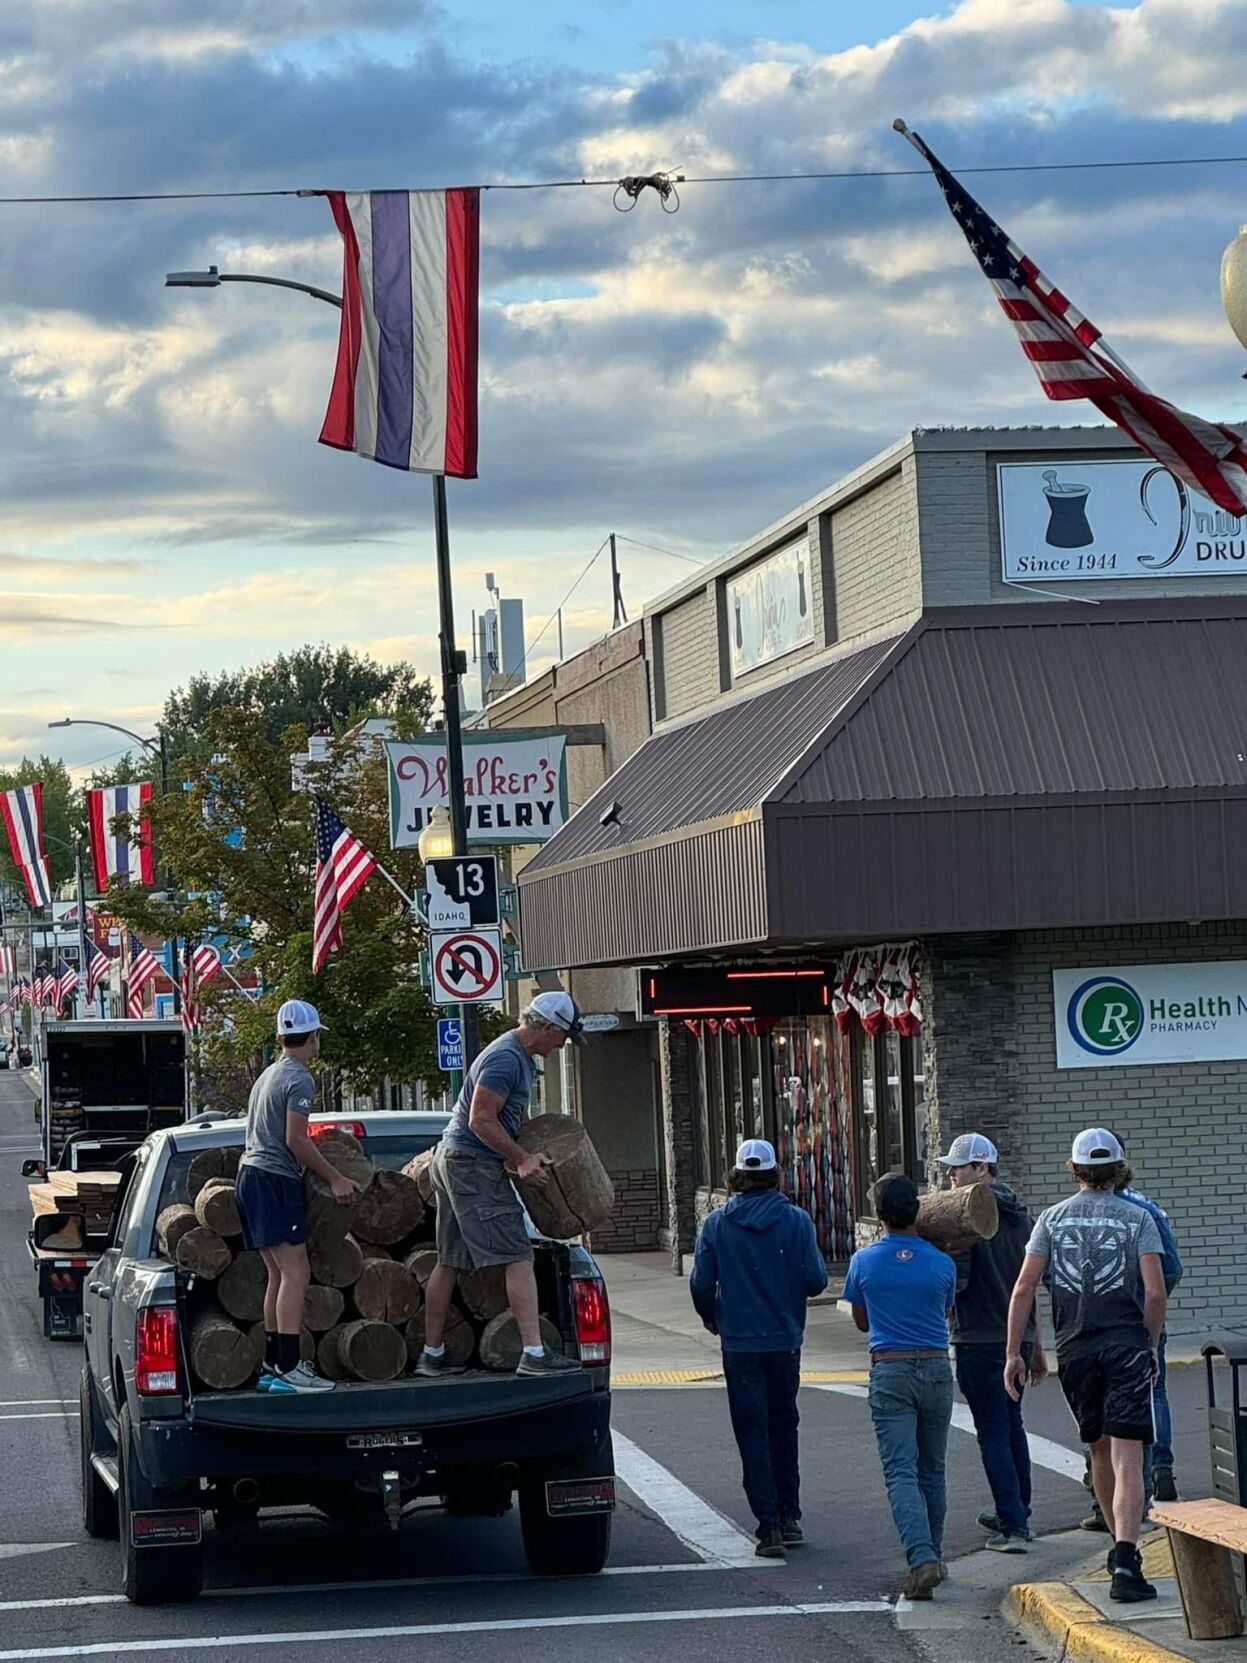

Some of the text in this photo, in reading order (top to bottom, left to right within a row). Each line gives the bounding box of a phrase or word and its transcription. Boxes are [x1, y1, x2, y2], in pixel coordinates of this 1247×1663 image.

[1017, 553, 1117, 572] Since 1944
[397, 755, 556, 798] Walker's
[406, 801, 554, 832] JELRY
[456, 863, 484, 896] 13
[434, 911, 466, 921] IDAHO
[1150, 996, 1231, 1020] Health
[1150, 1020, 1217, 1032] PHARMACY
[440, 1045, 461, 1055] PARKI
